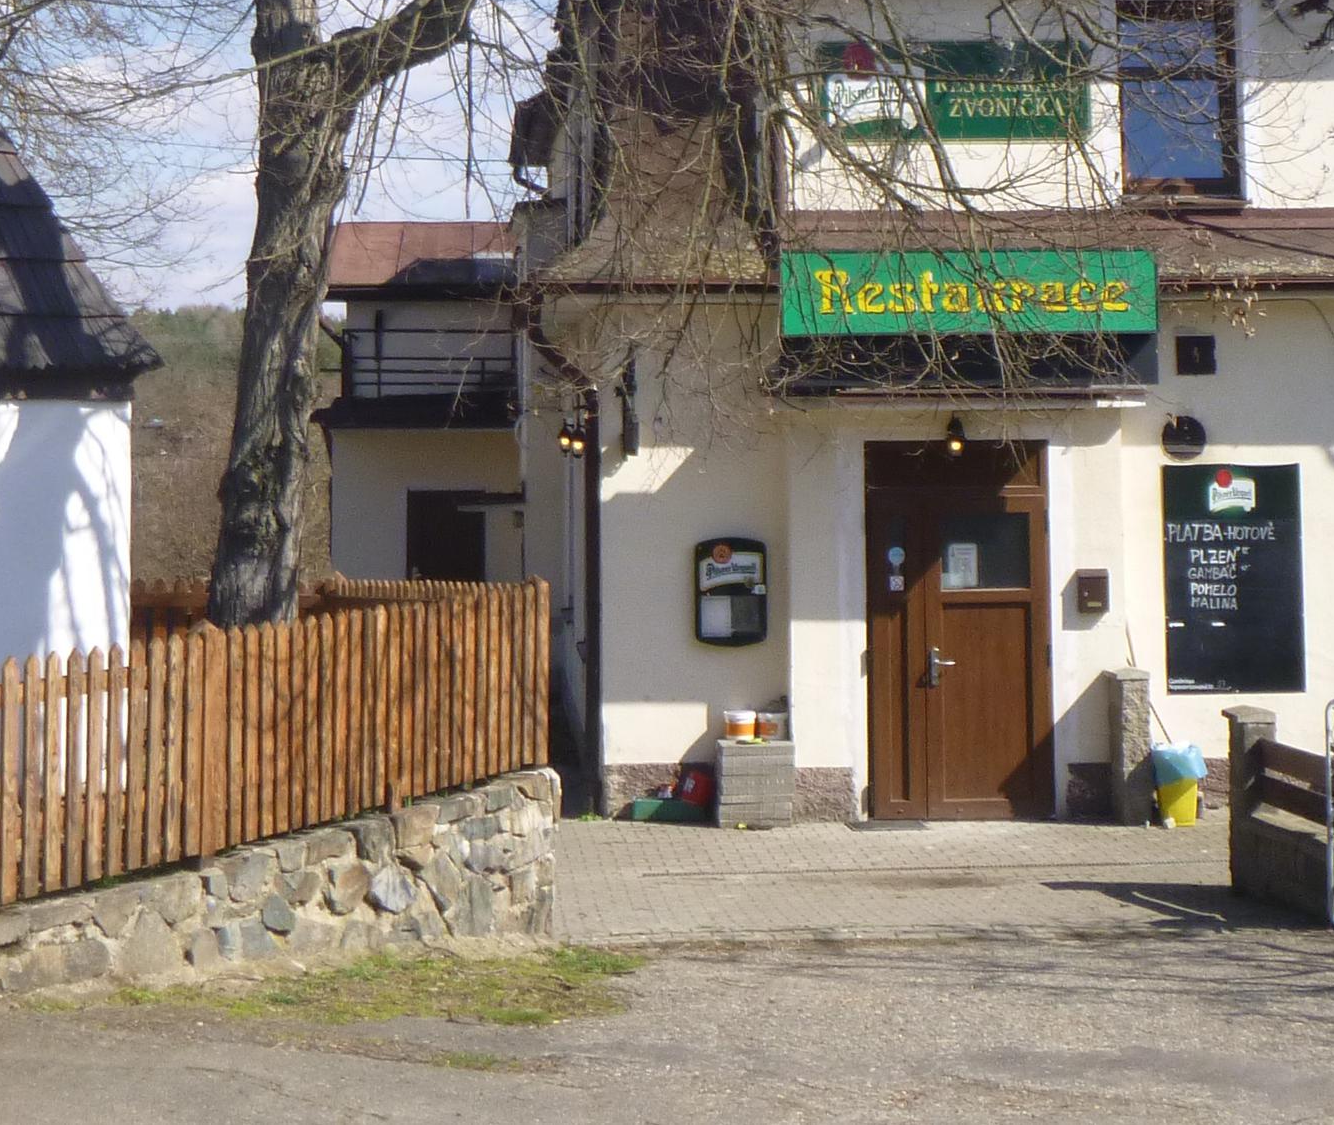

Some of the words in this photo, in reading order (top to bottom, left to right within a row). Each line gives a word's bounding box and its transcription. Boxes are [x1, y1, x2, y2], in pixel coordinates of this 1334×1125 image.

[949, 92, 1066, 117] ZVONIČKA
[815, 269, 1131, 315] Restaurace
[1190, 582, 1237, 596] POMELO
